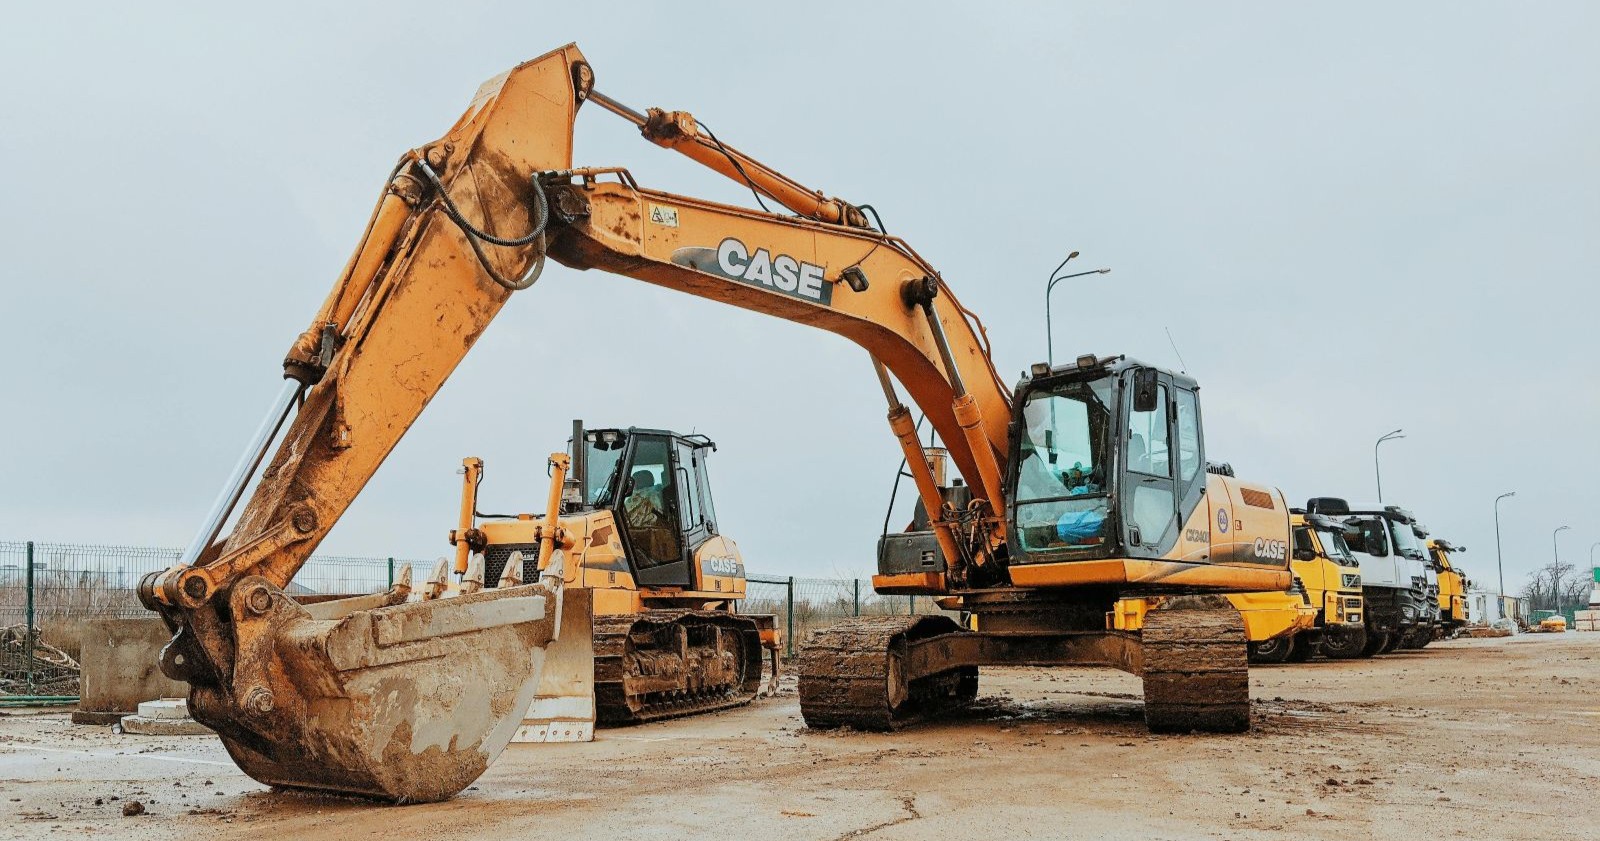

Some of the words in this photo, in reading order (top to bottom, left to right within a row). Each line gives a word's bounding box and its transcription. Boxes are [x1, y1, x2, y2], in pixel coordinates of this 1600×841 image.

[717, 237, 825, 299] CASE
[1254, 537, 1286, 559] CASE
[710, 555, 737, 573] CASE
